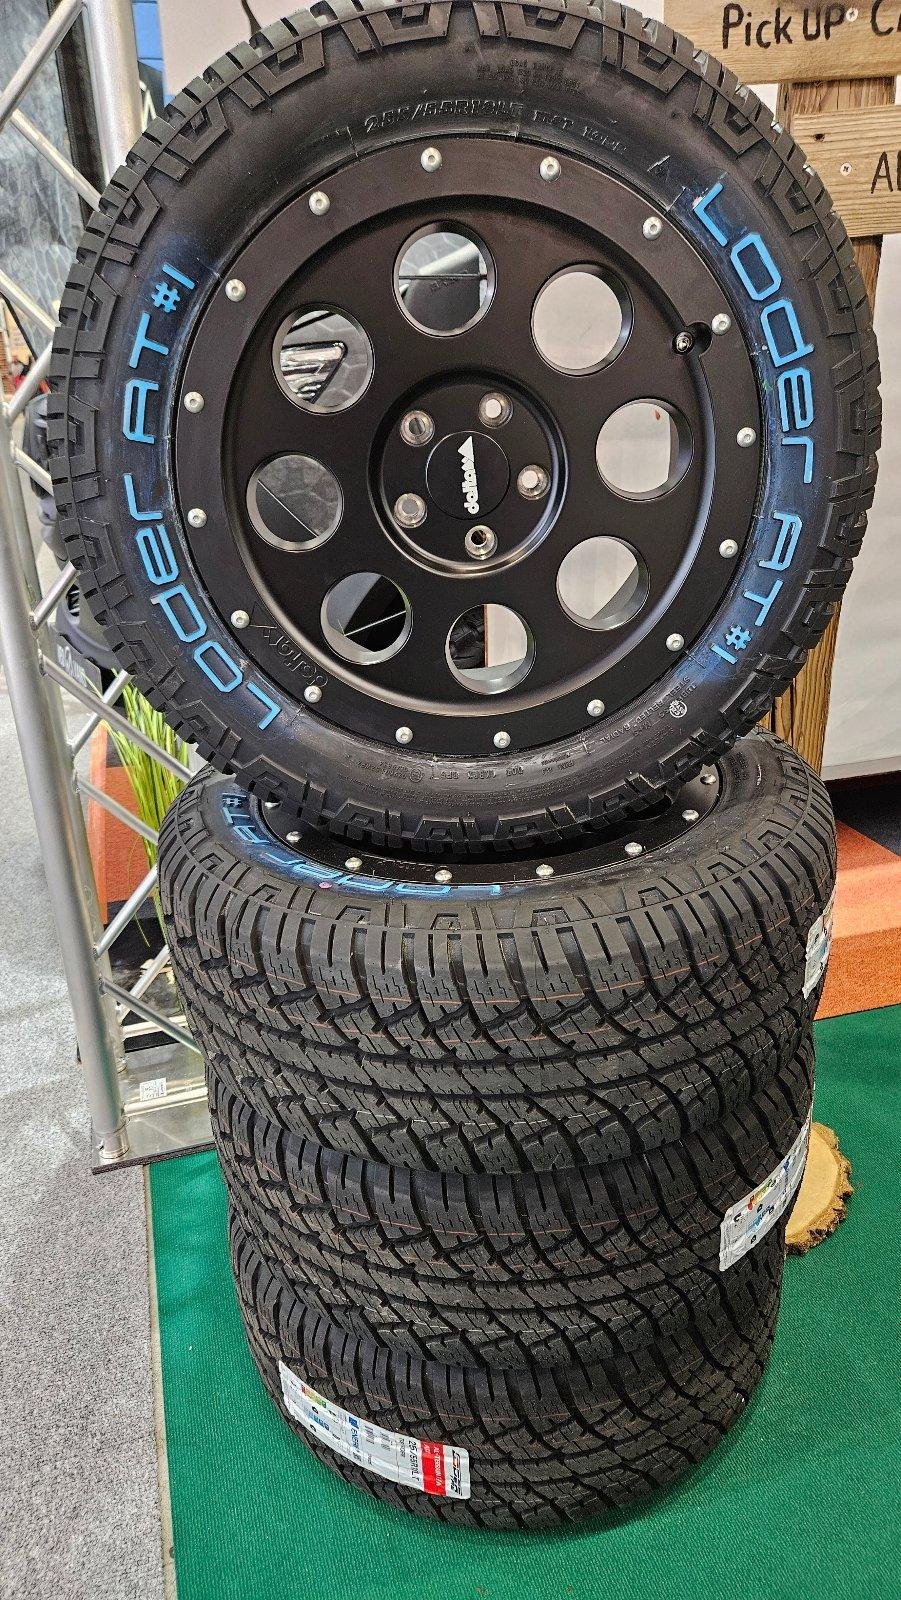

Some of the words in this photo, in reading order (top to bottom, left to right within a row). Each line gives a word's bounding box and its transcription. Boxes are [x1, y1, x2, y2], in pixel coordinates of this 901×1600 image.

[722, 3, 793, 50] Pick
[870, 0, 901, 37] C
[869, 150, 901, 195] A
[600, 722, 631, 744] RADIAL
